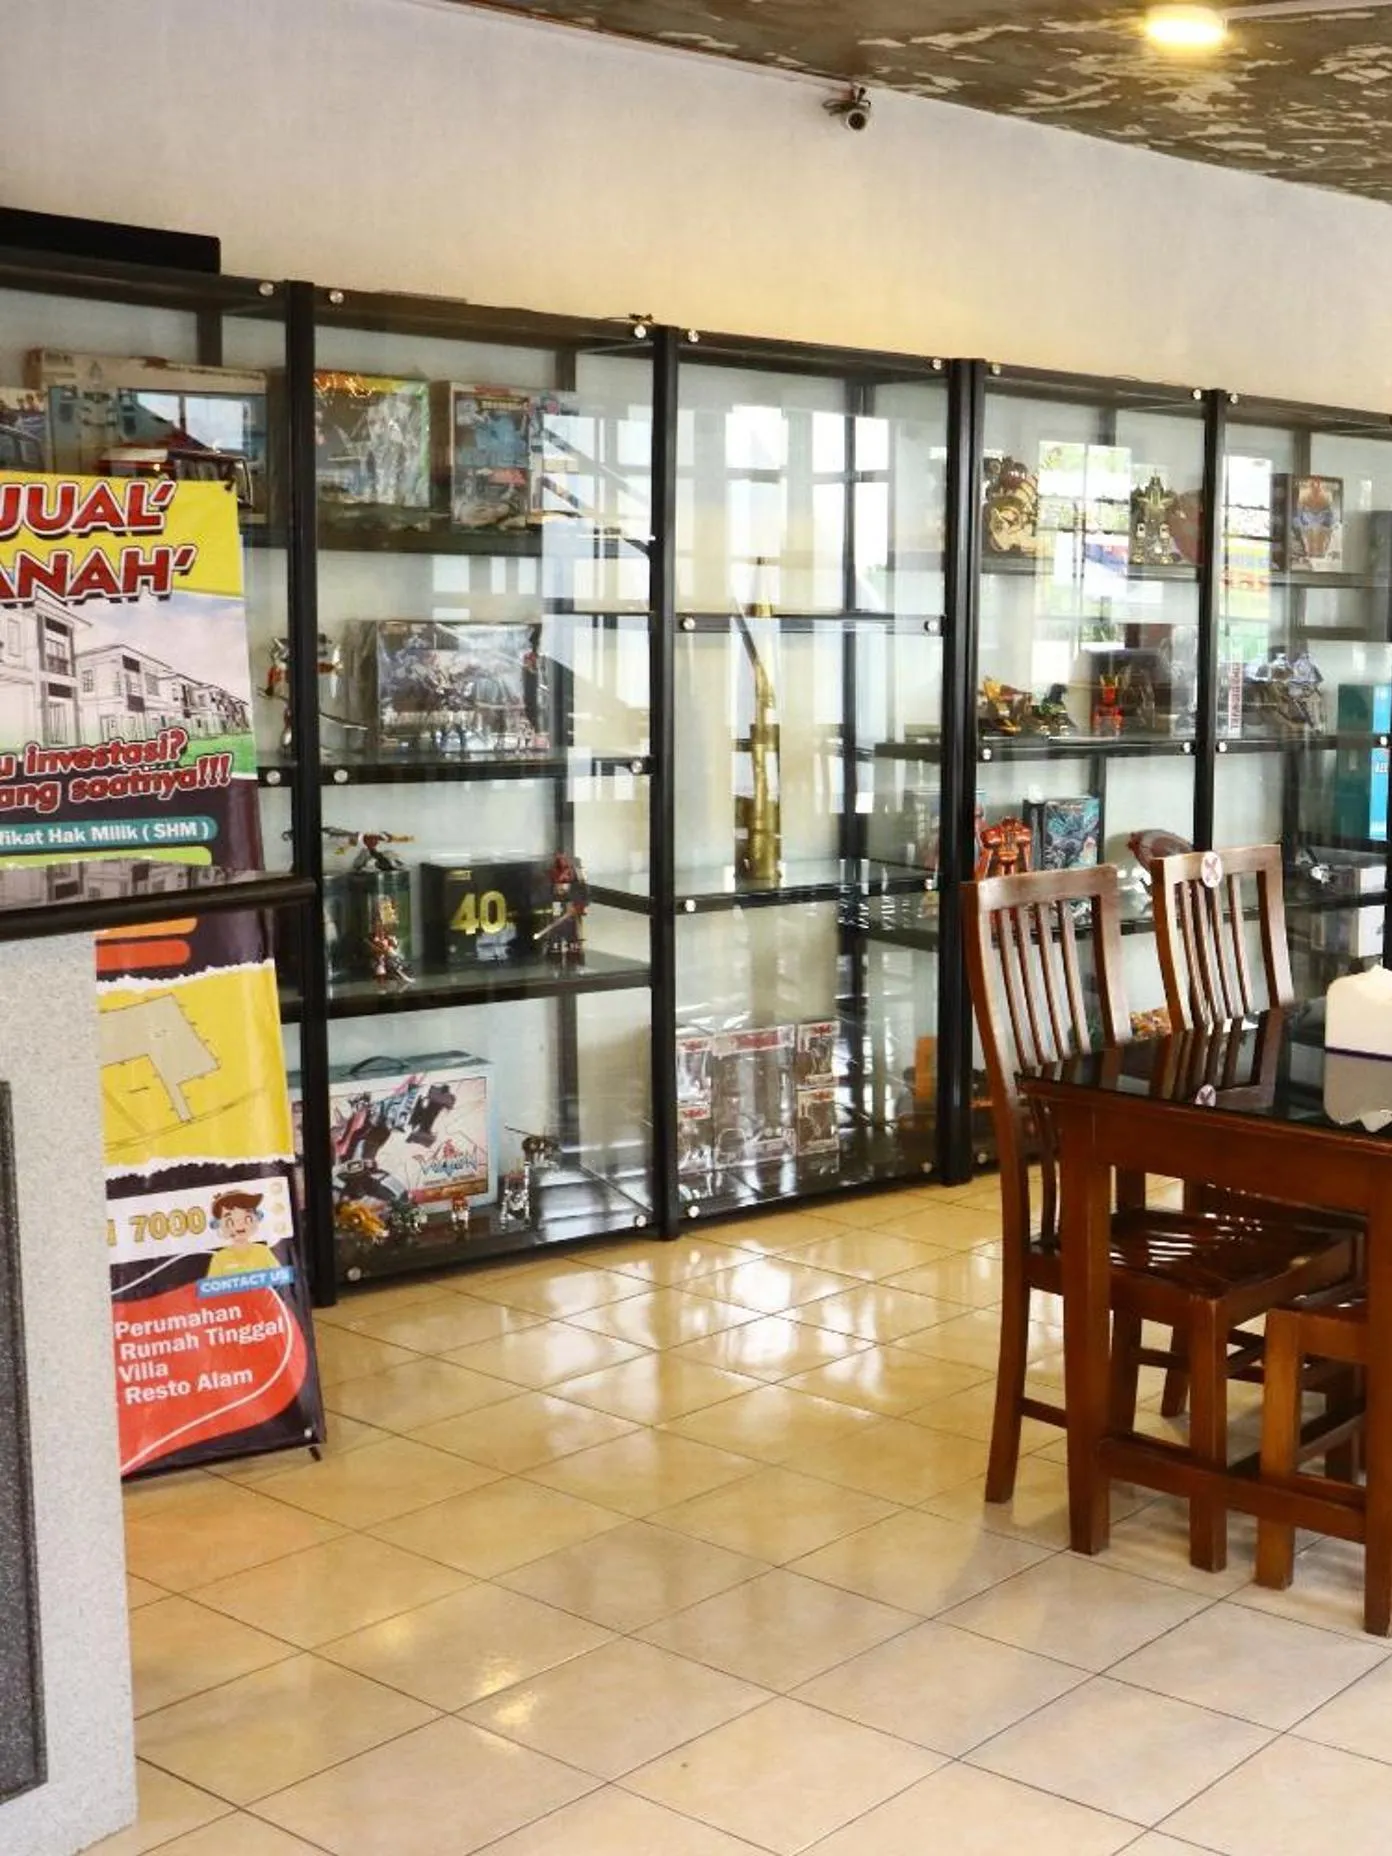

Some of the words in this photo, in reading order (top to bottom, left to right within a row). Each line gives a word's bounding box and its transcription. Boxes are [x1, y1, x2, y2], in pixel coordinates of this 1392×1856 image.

[24, 727, 188, 776] investasi?
[68, 752, 232, 803] saatnya!!!
[48, 826, 86, 844] Hak
[91, 823, 138, 842] Milik
[450, 890, 507, 935] 40
[128, 1205, 207, 1243] 7000
[200, 1272, 267, 1293] CONTACT
[270, 1267, 291, 1284] US
[114, 1305, 242, 1339] Perumahan
[120, 1332, 200, 1361] Rumah
[204, 1317, 284, 1347] Tinggal
[118, 1361, 169, 1384] Villa
[125, 1379, 192, 1405] Resto
[197, 1367, 254, 1393] Alam
